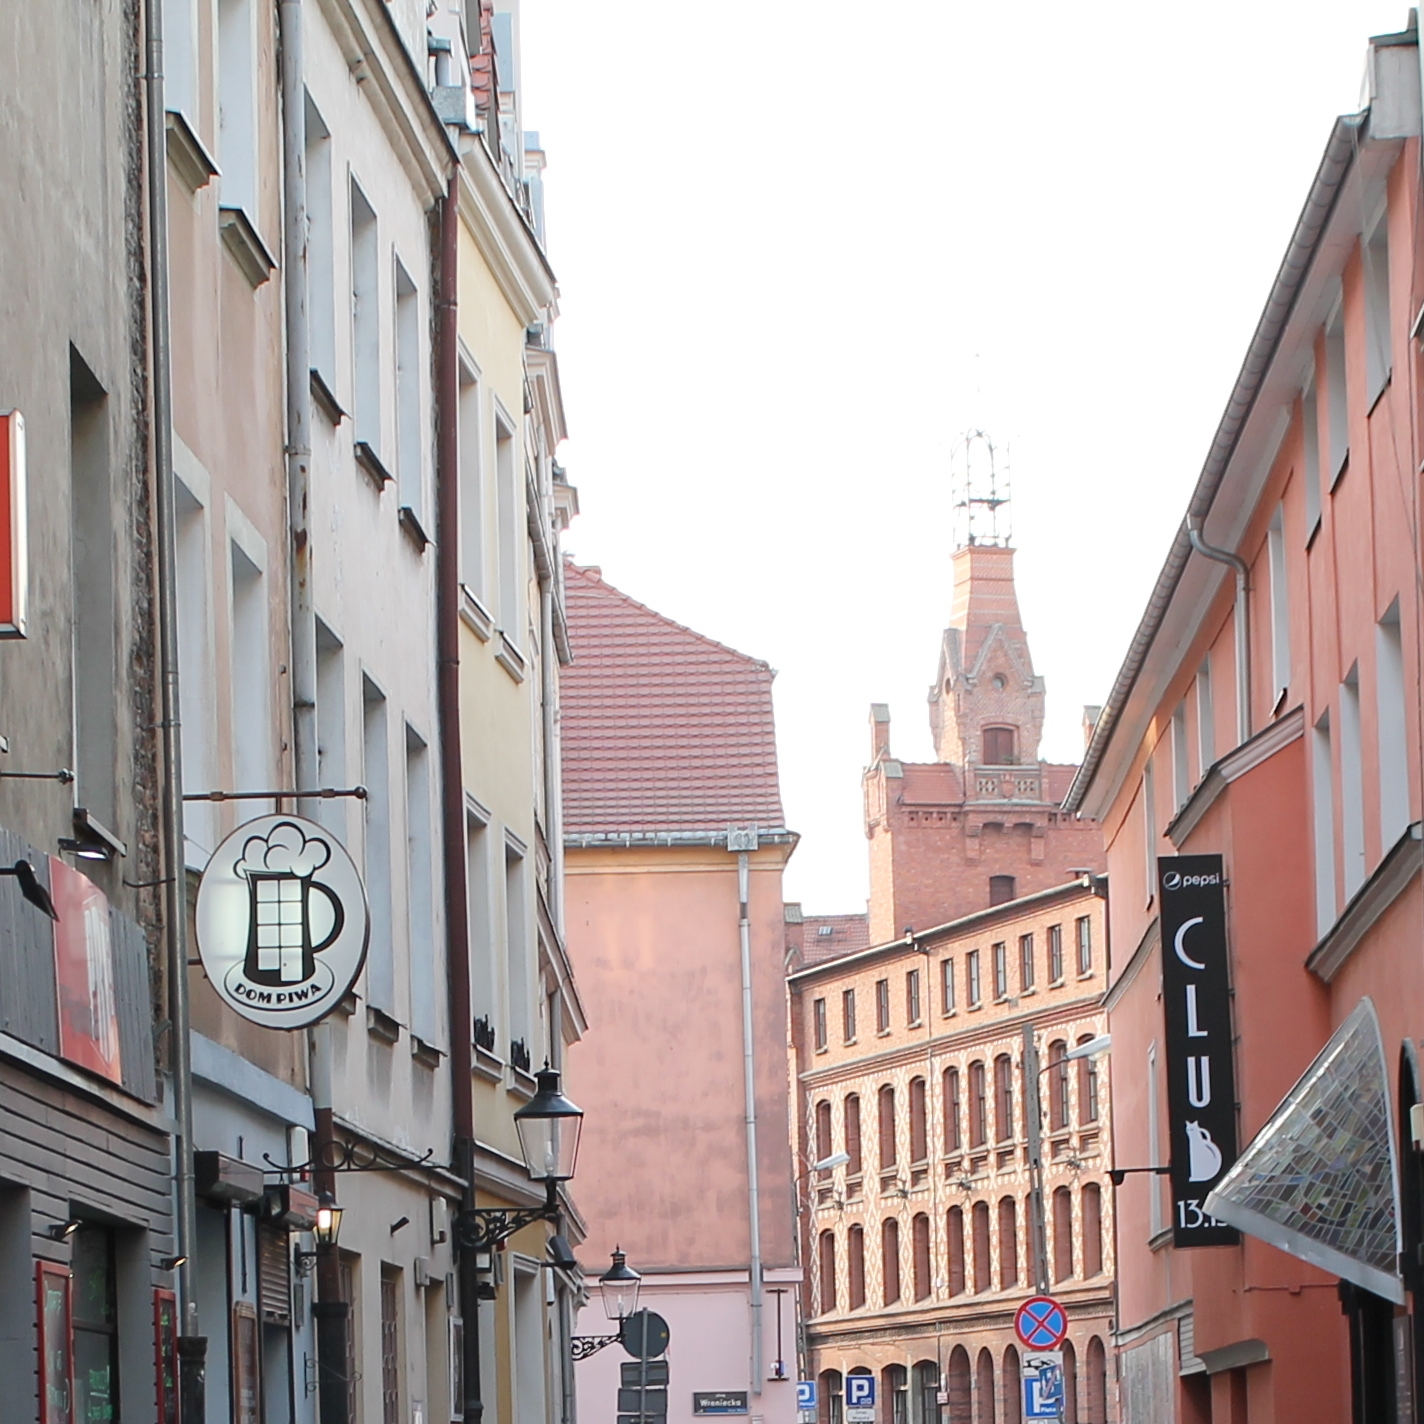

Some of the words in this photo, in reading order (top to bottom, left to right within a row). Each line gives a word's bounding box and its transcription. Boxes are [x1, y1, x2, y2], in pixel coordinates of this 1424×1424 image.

[1183, 873, 1220, 889] pepsi
[233, 982, 273, 1004] DOM
[276, 983, 323, 1005] PIWA
